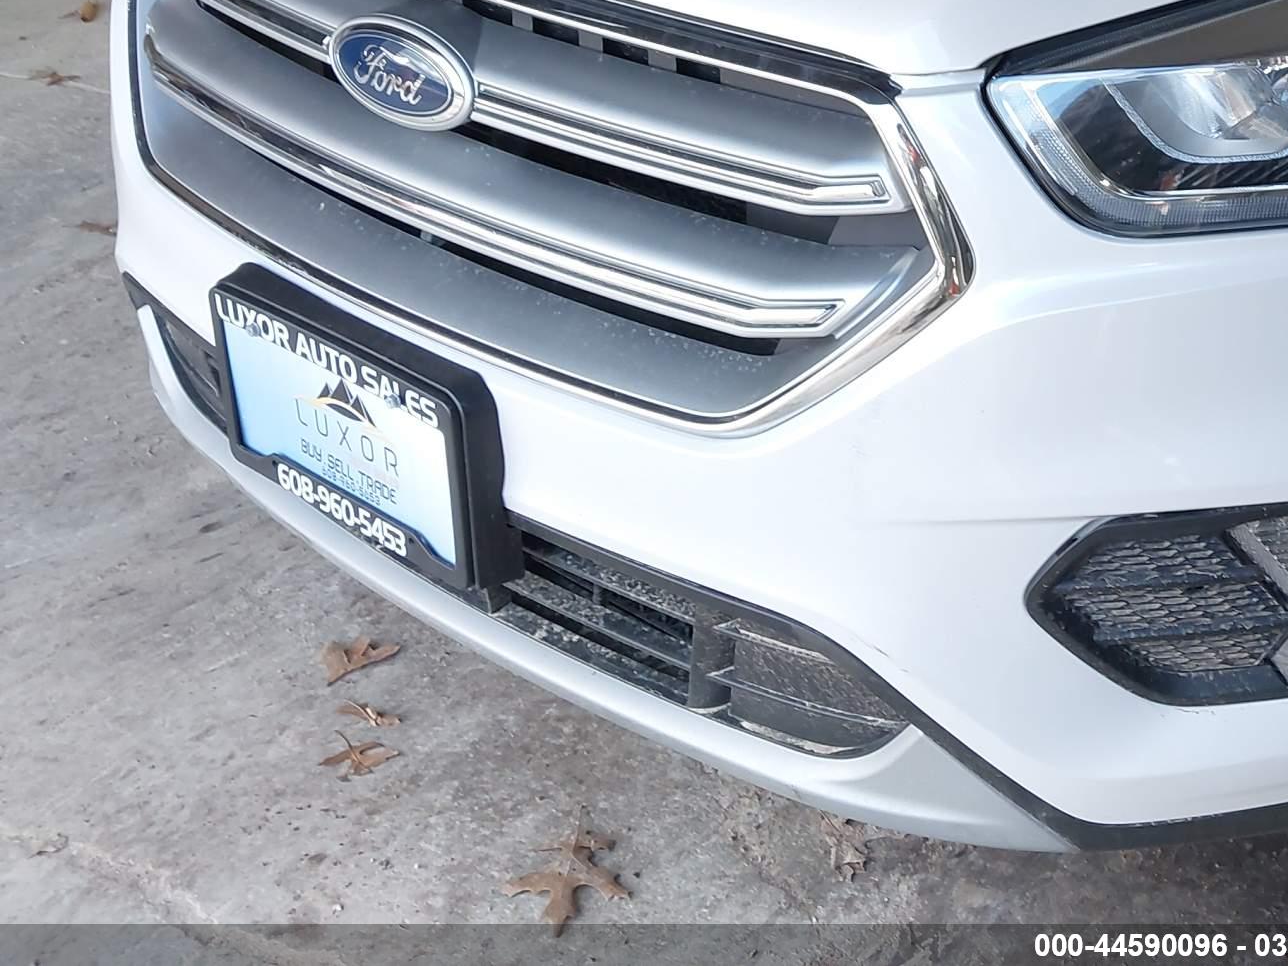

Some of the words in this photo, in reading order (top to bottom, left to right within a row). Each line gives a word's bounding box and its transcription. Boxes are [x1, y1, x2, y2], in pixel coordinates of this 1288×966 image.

[353, 44, 426, 105] Ford
[214, 293, 293, 352] LUXOR
[295, 331, 357, 383] AUTO
[360, 365, 439, 428] SALES
[295, 398, 399, 477] LUXOR
[301, 438, 323, 463] BUY
[327, 453, 354, 481] SELL
[358, 470, 397, 505] TRADE
[277, 462, 408, 557] 608-960-5453
